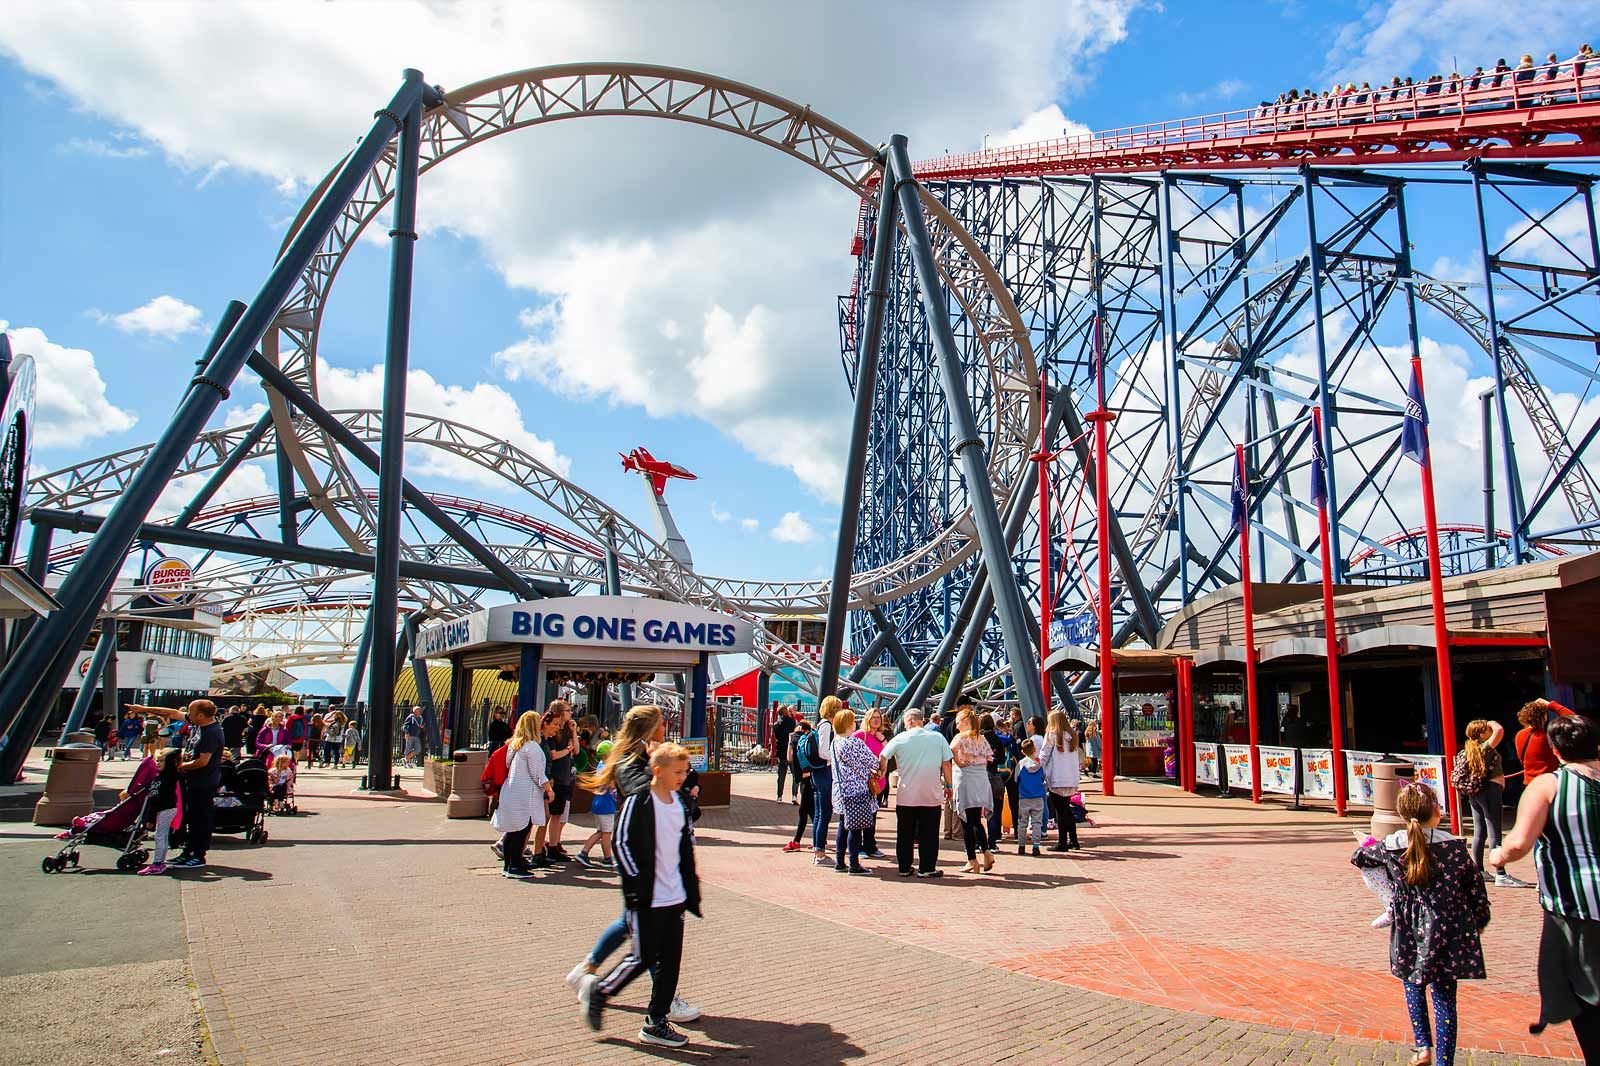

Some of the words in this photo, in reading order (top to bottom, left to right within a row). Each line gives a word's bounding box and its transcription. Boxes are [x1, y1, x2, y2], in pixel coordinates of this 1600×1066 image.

[153, 569, 190, 579] BURGER
[447, 619, 469, 647] GAMES
[512, 611, 565, 637] BIG
[572, 615, 636, 641] ONE
[643, 619, 736, 646] GAMES
[1266, 757, 1277, 768] BIG
[1308, 761, 1317, 772] BIG
[1353, 764, 1365, 777] BIG
